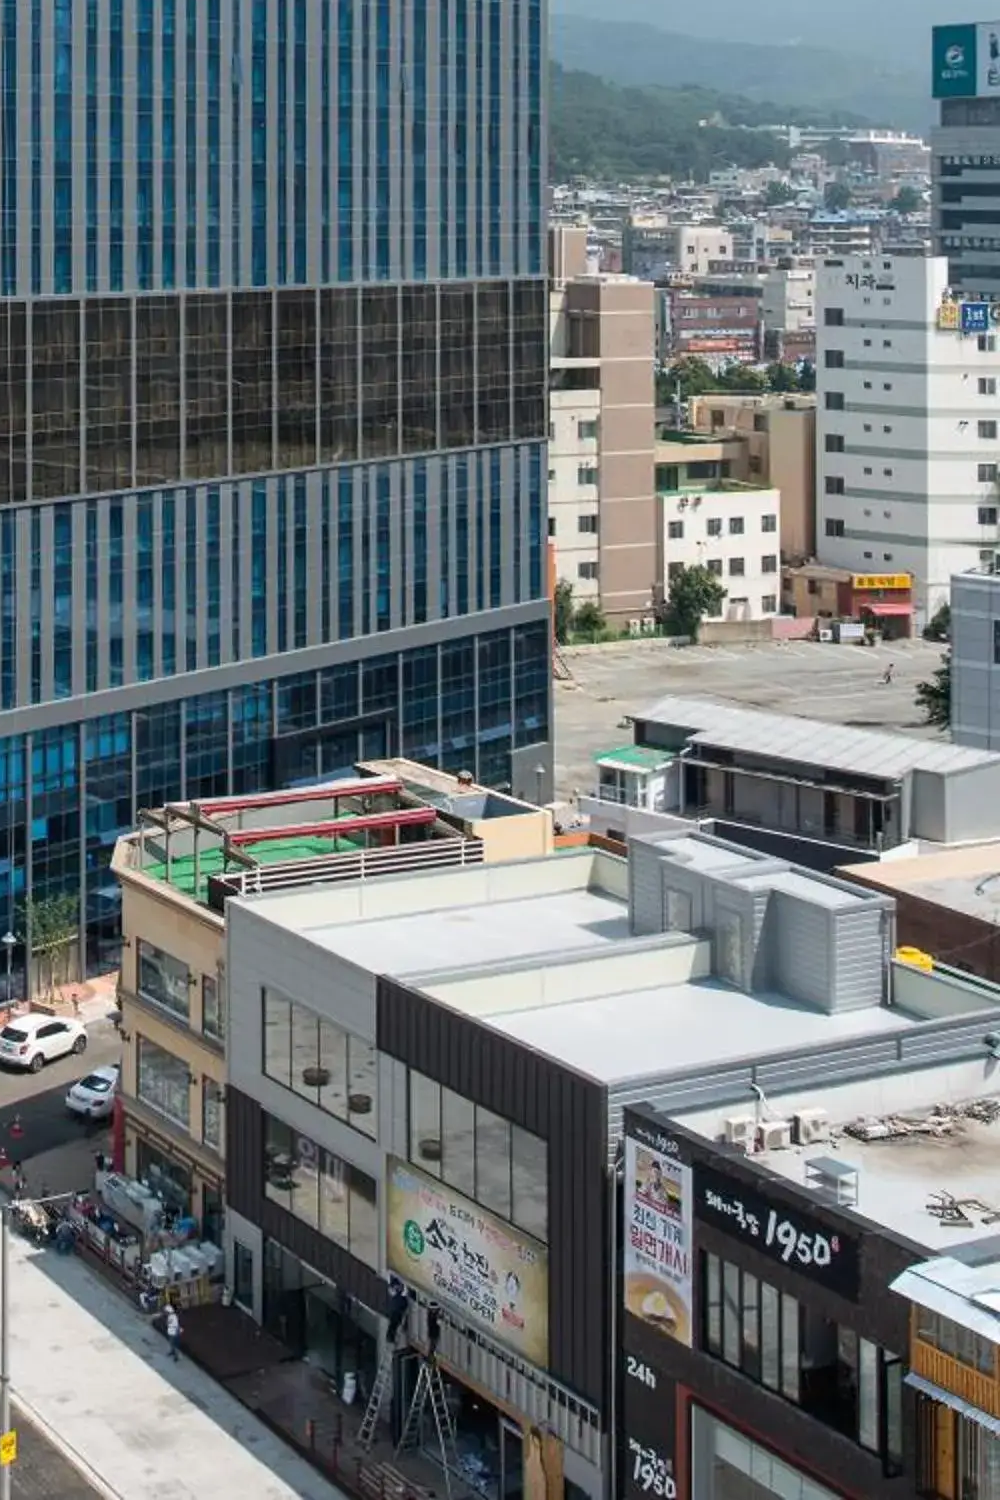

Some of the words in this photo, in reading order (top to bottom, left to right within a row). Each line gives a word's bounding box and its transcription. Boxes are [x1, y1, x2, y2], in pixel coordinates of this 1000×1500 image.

[765, 1211, 832, 1266] 1950
[627, 1356, 656, 1389] 24h
[633, 1455, 677, 1499] 1950
